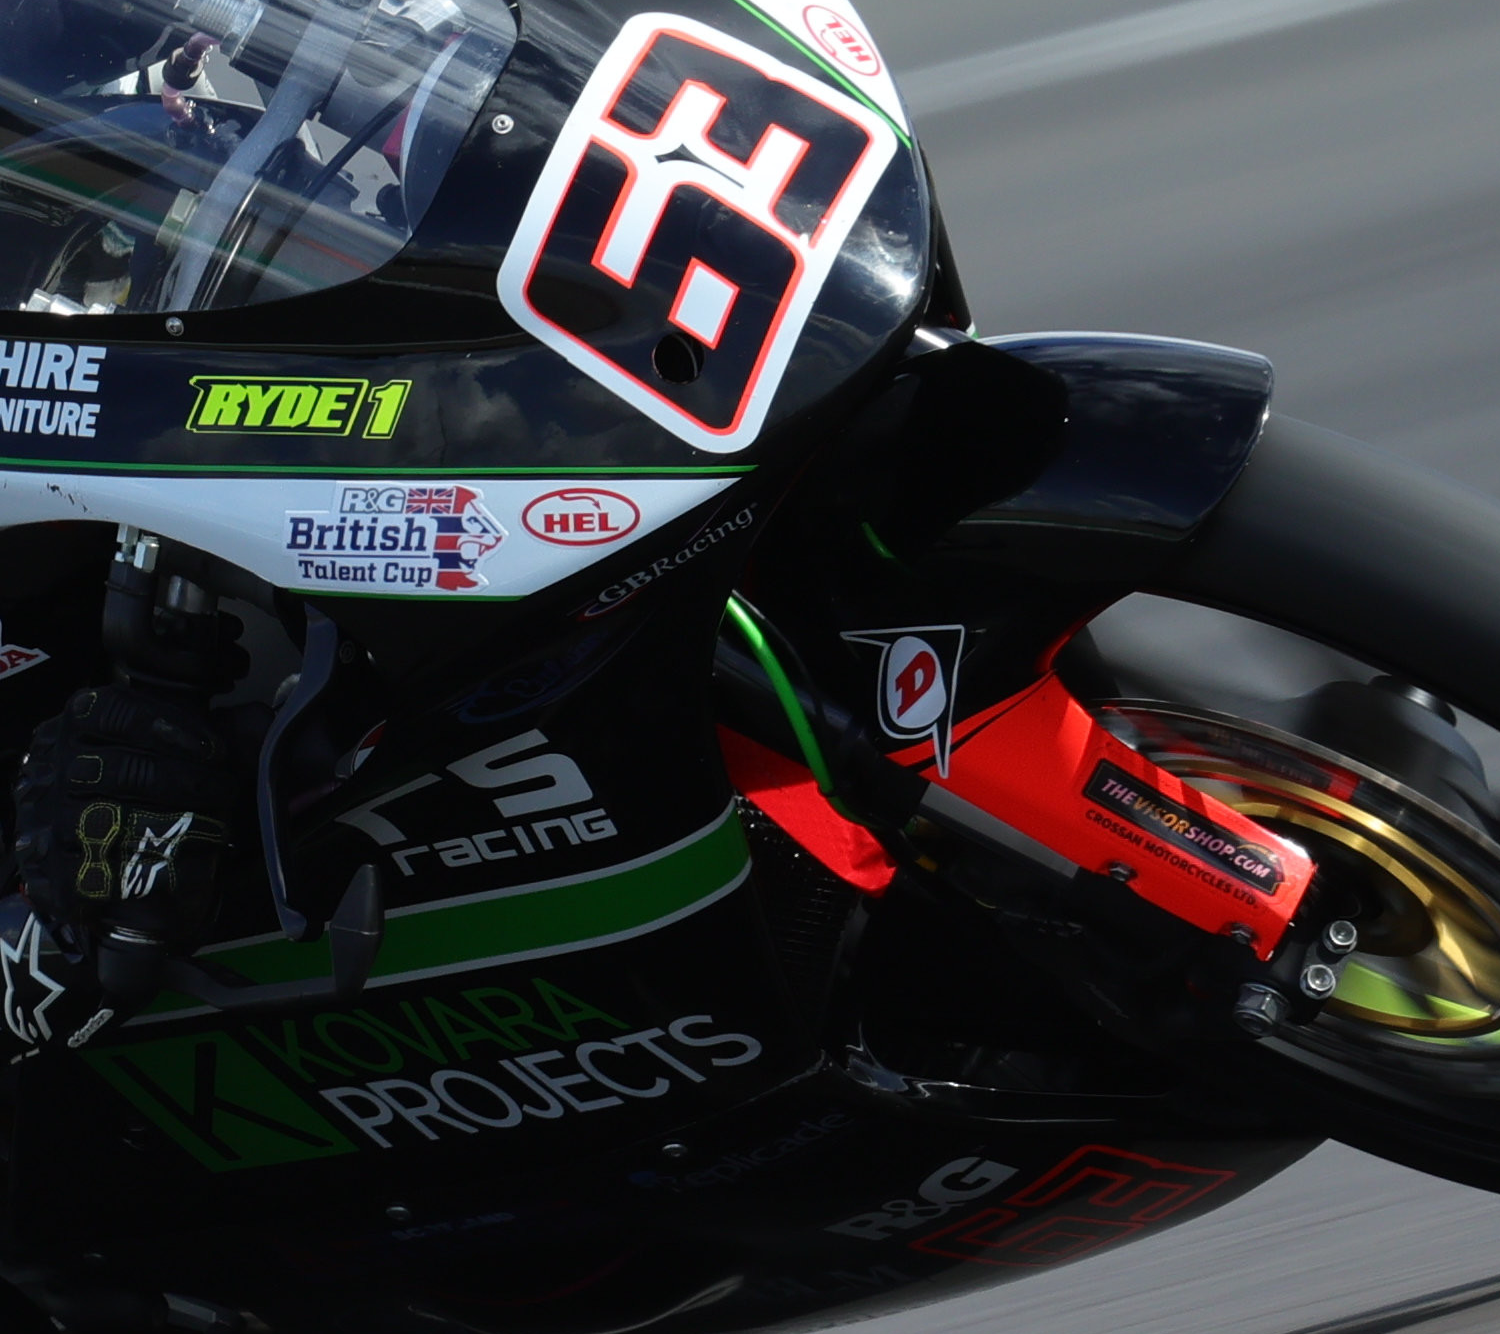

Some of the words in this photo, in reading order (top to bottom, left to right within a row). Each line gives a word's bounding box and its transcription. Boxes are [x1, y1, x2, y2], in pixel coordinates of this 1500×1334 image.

[826, 16, 872, 63] HEL
[523, 28, 874, 435] 63
[286, 516, 427, 552] British
[339, 487, 406, 514] R&G
[543, 513, 621, 534] HEL
[297, 559, 377, 584] Talent
[381, 561, 433, 587] Cup
[598, 506, 756, 604] GBRacing
[894, 649, 937, 719] D
[1085, 809, 1143, 847] CROSSAN
[1144, 840, 1231, 894] MOTORCYCLES
[1100, 779, 1272, 879] THEVISORSHOP.COM
[247, 978, 628, 1085] KOVARA
[317, 1014, 763, 1149] PROJECTS
[823, 1155, 1020, 1242] R&G
